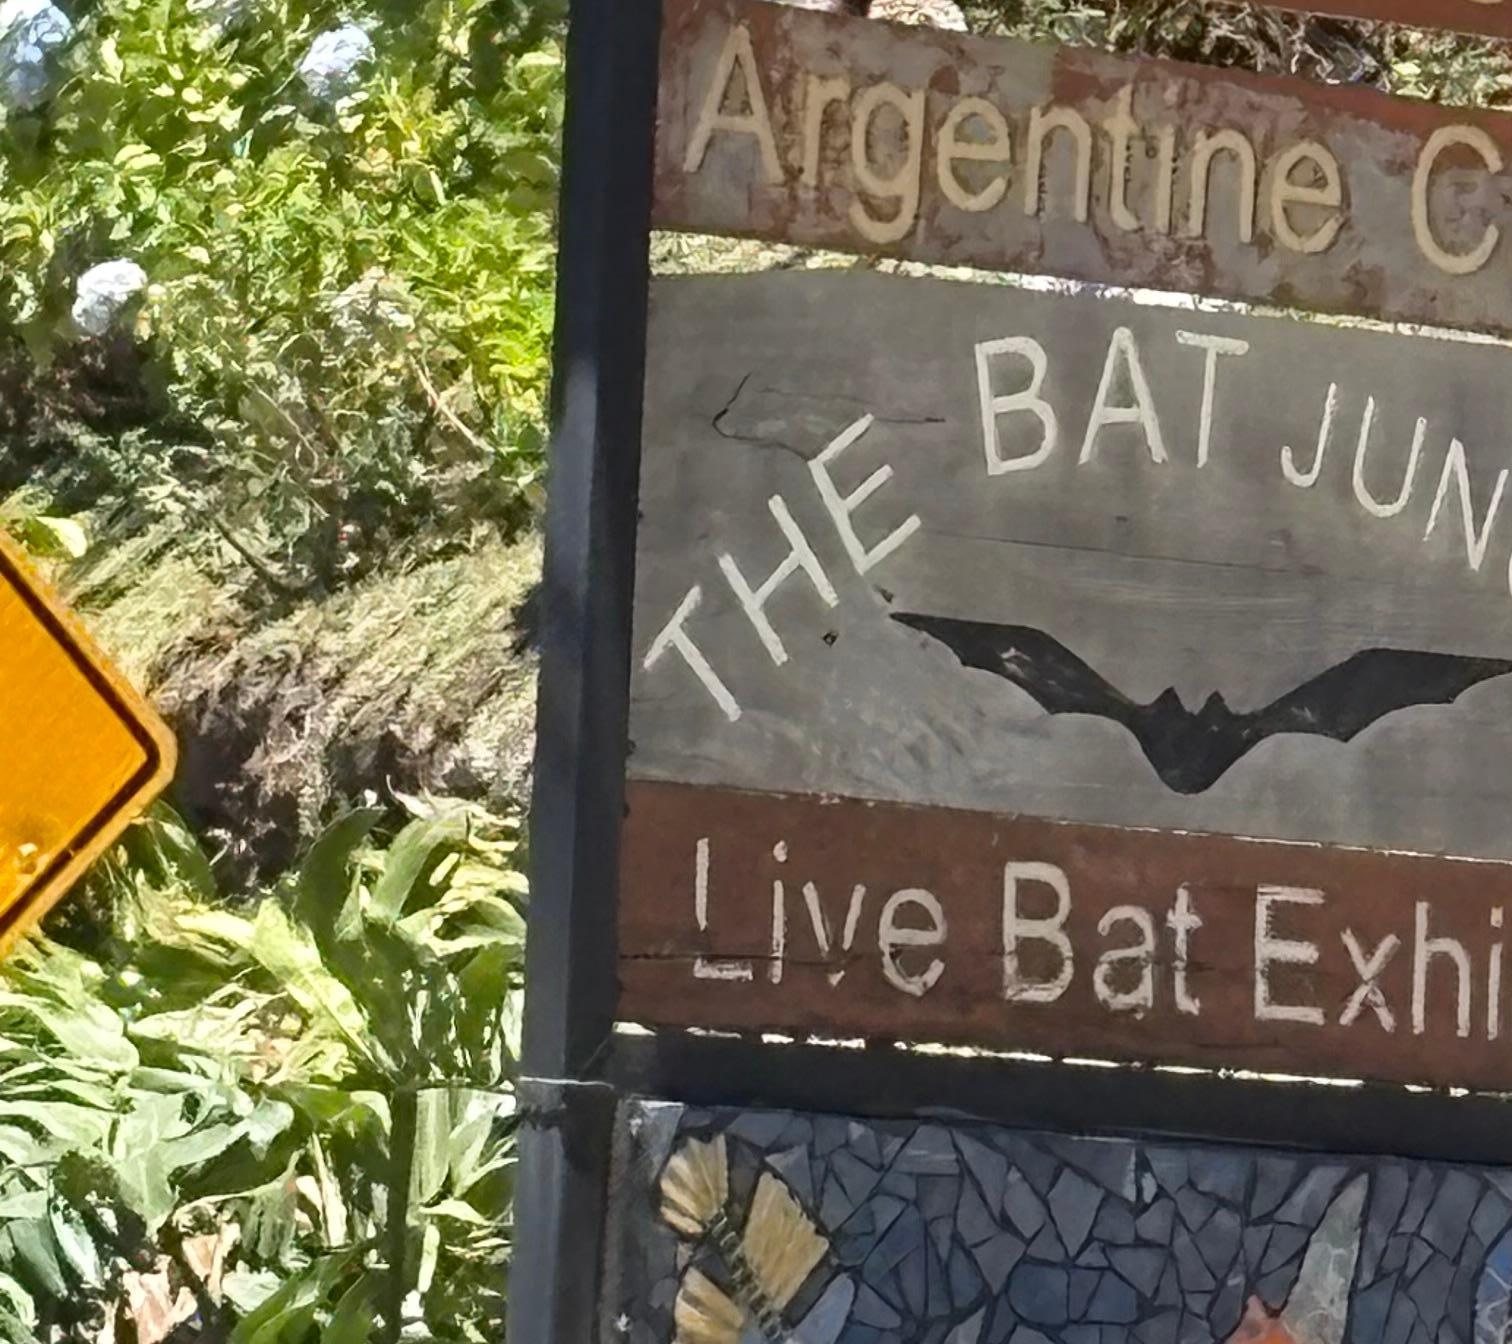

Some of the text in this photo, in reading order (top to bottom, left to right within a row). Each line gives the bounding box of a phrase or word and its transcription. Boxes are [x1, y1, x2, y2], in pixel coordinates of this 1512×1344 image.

[684, 30, 1346, 254] Argentine
[643, 413, 923, 721] THE
[972, 327, 1249, 475] BAT
[692, 838, 947, 994] Live
[1002, 862, 1200, 1018] Bat
